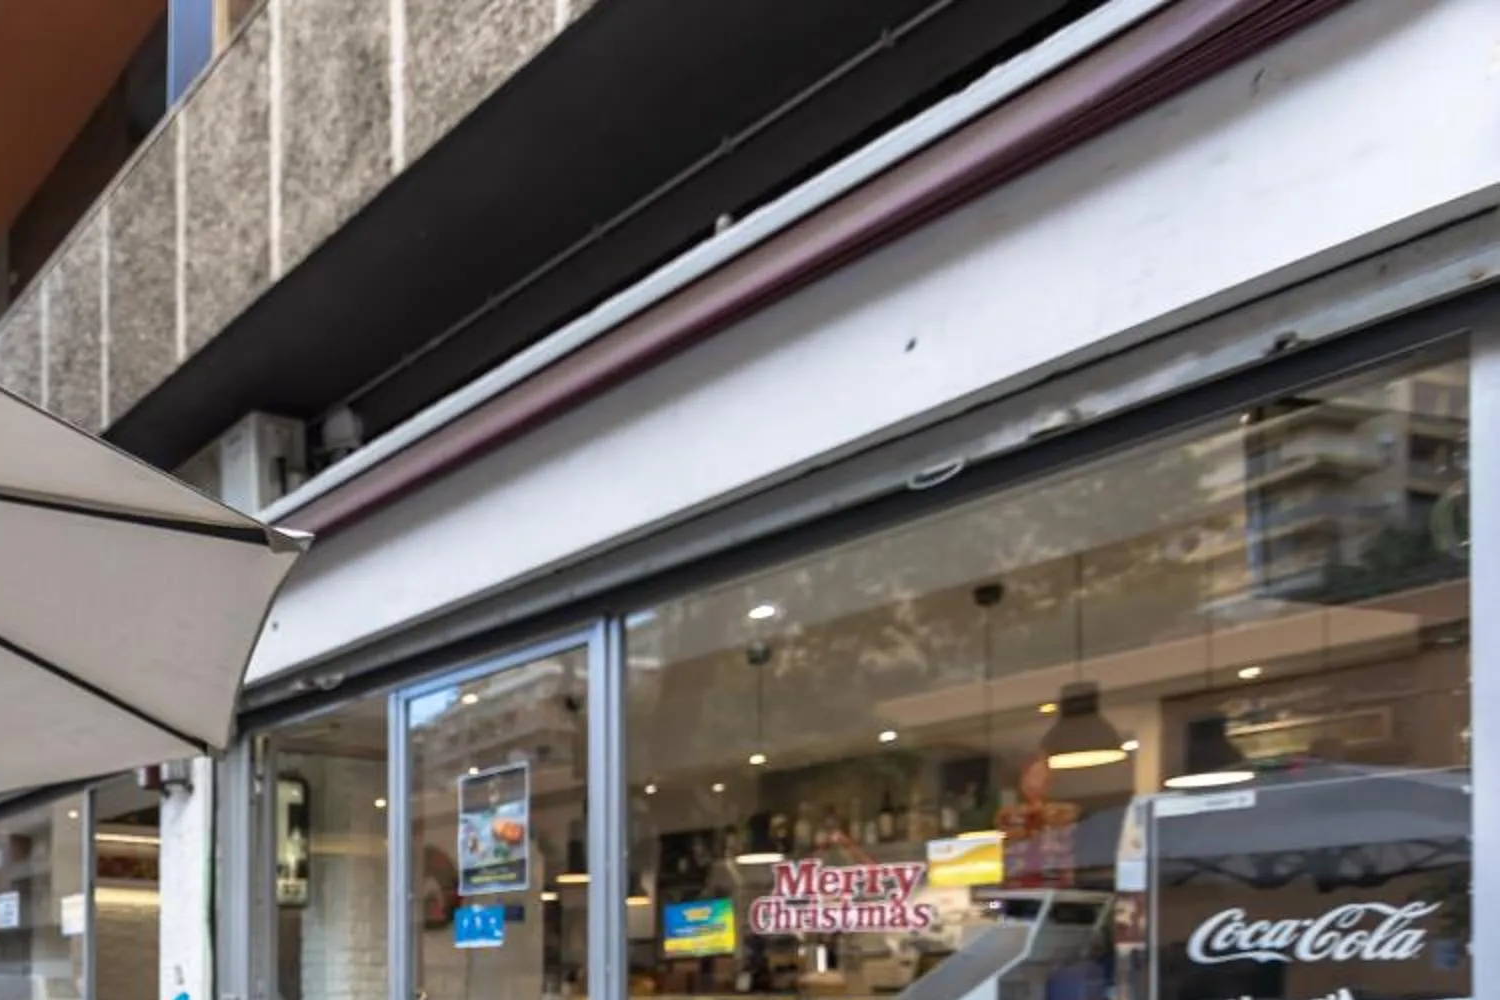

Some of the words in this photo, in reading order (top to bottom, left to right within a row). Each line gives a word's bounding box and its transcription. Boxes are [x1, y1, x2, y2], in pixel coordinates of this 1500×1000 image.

[773, 859, 925, 900] Merry
[752, 898, 933, 933] Christmas
[1187, 901, 1443, 964] Coca-Cola
